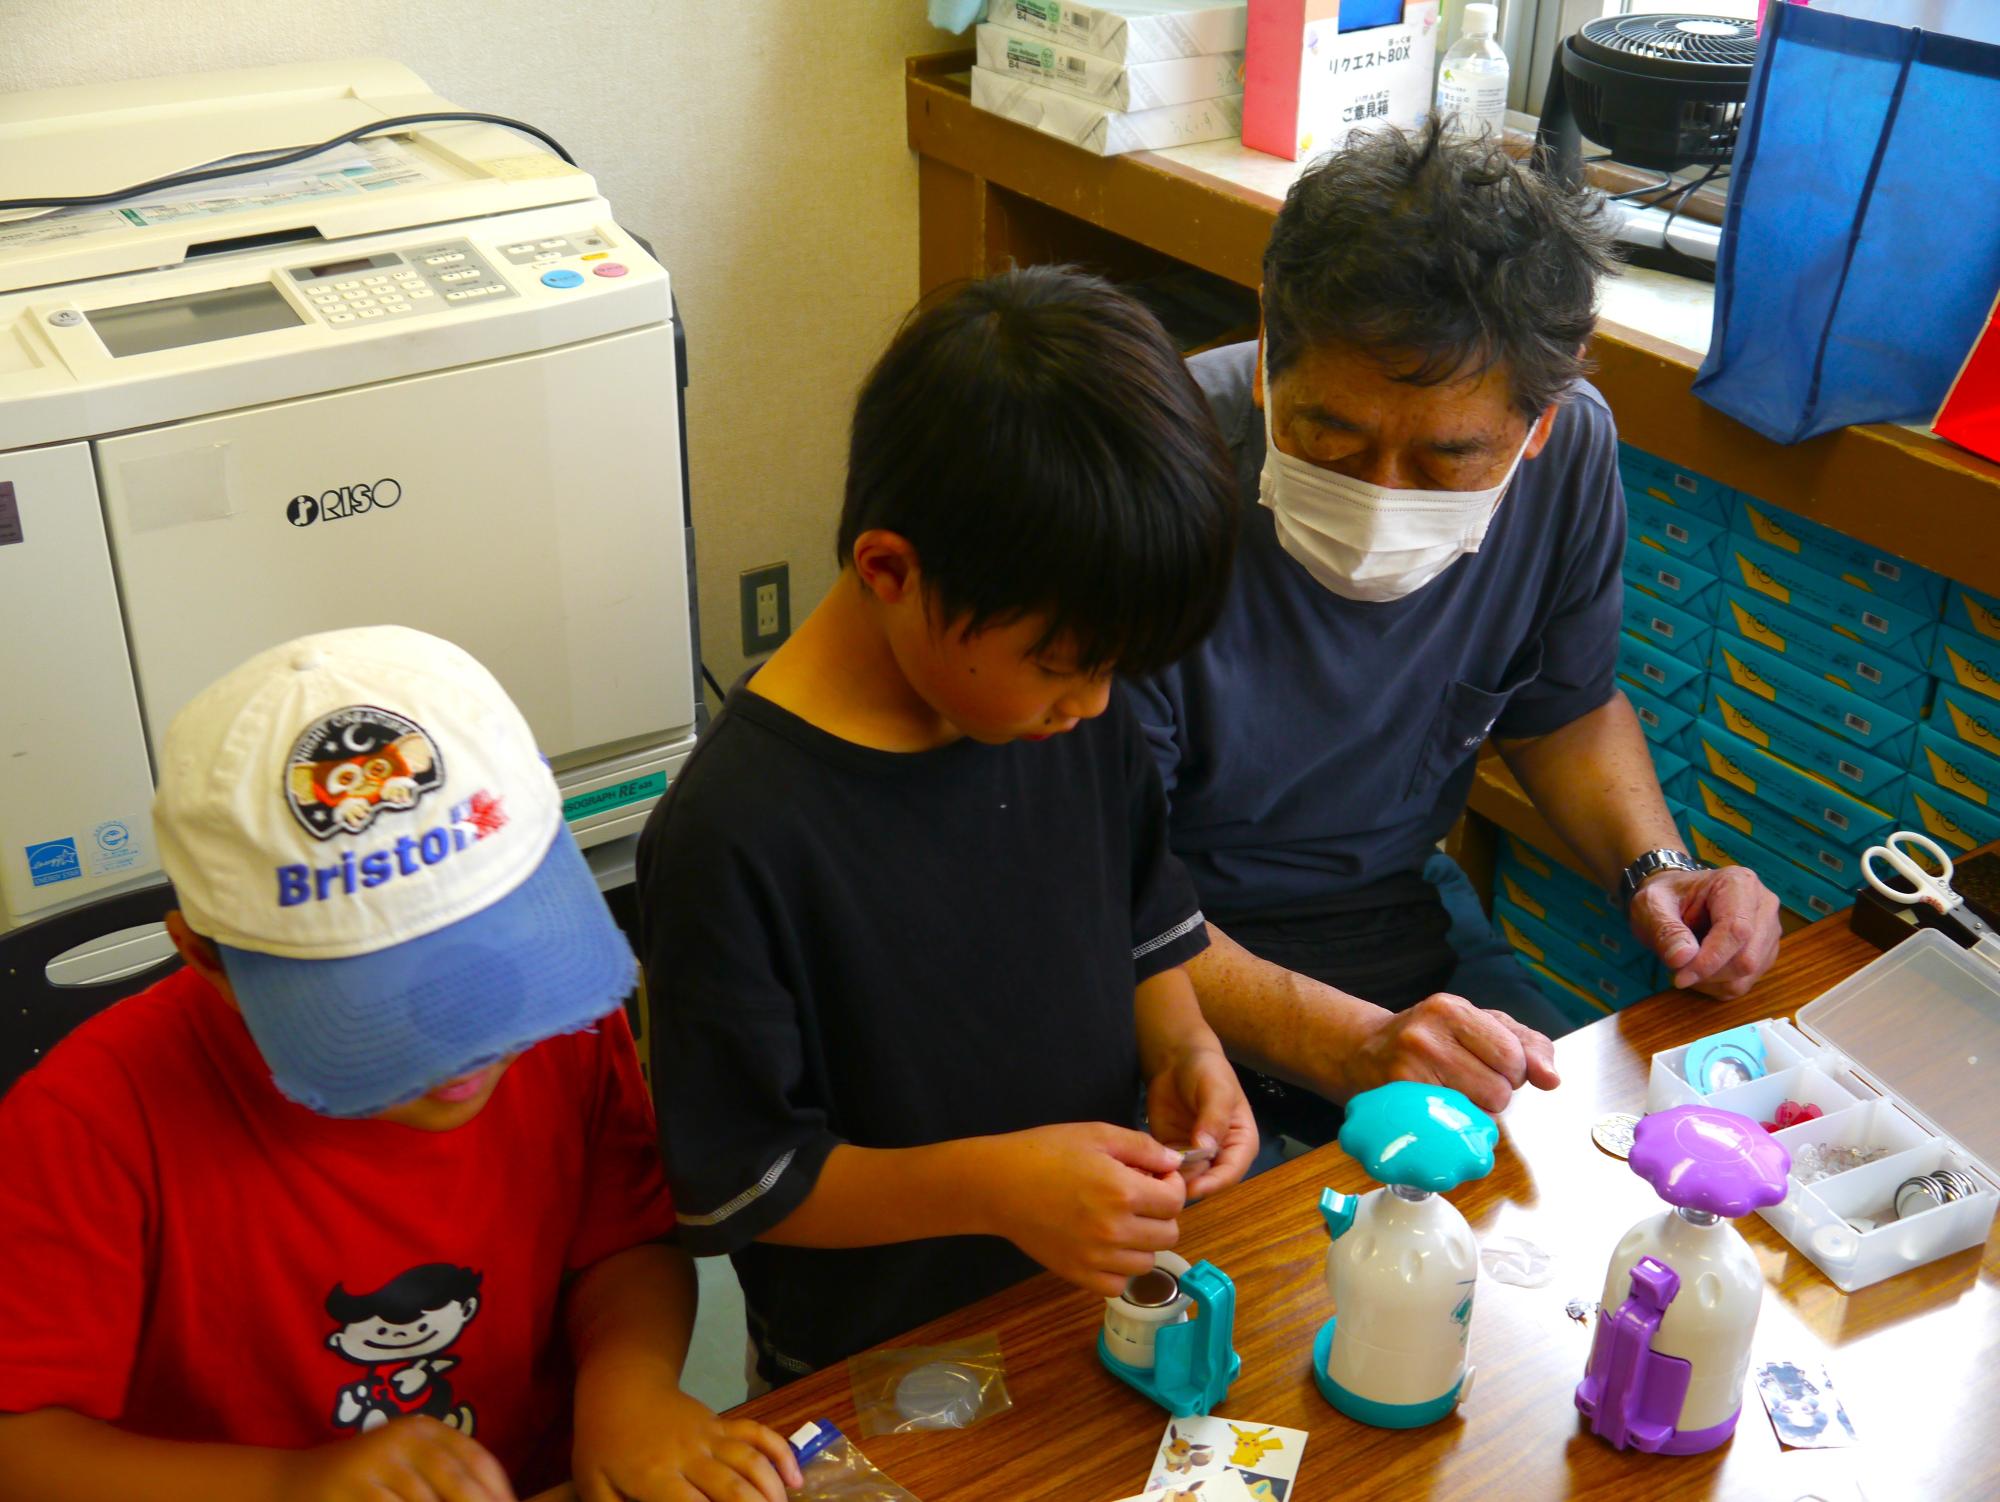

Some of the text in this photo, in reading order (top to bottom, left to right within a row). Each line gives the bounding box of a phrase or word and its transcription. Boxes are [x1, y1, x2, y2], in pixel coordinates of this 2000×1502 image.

[1329, 45, 1411, 74] リクエストBOX
[1342, 99, 1389, 122] ご意見箱
[320, 478, 401, 522] RISO
